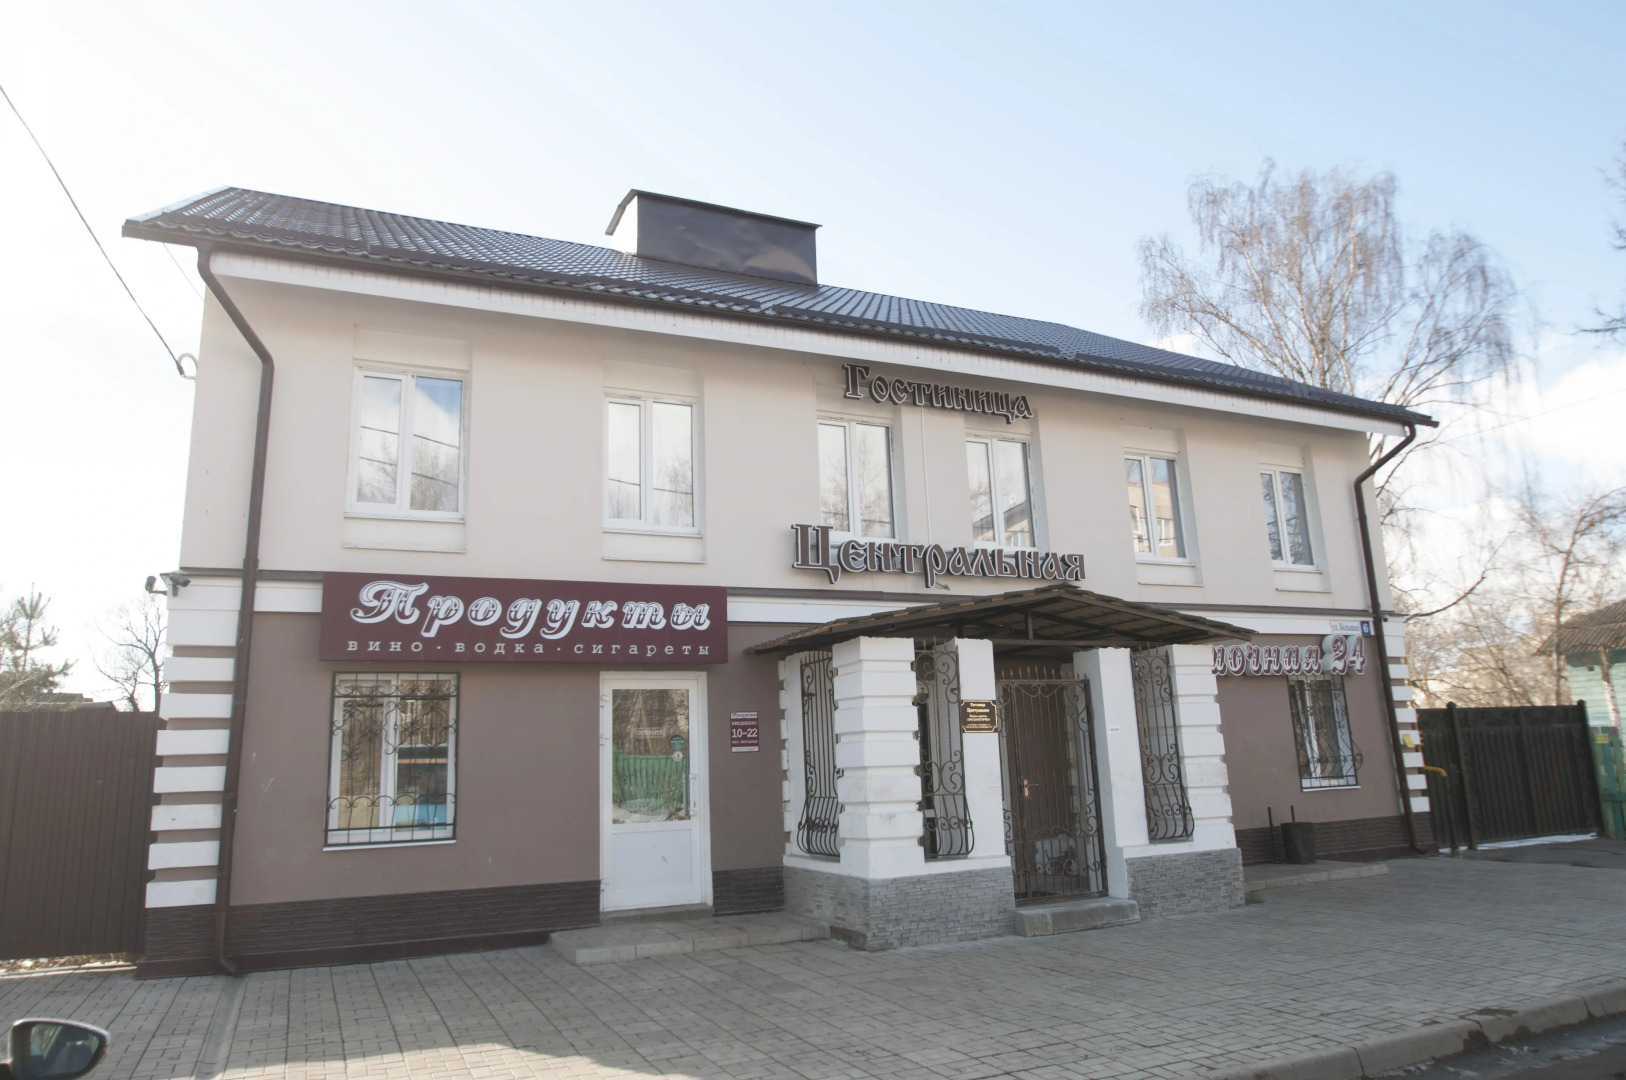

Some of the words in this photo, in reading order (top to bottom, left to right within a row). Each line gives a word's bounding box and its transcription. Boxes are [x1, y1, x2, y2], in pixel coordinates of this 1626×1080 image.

[843, 363, 1035, 424] Гостиница
[791, 524, 1087, 588] Центральная
[350, 581, 711, 640] Продукты
[1362, 623, 1369, 634] 6
[347, 641, 423, 652] вино
[455, 642, 545, 655] водка
[574, 643, 710, 657] сигареты
[1331, 634, 1366, 675] 24
[732, 728, 758, 738] 10-22
